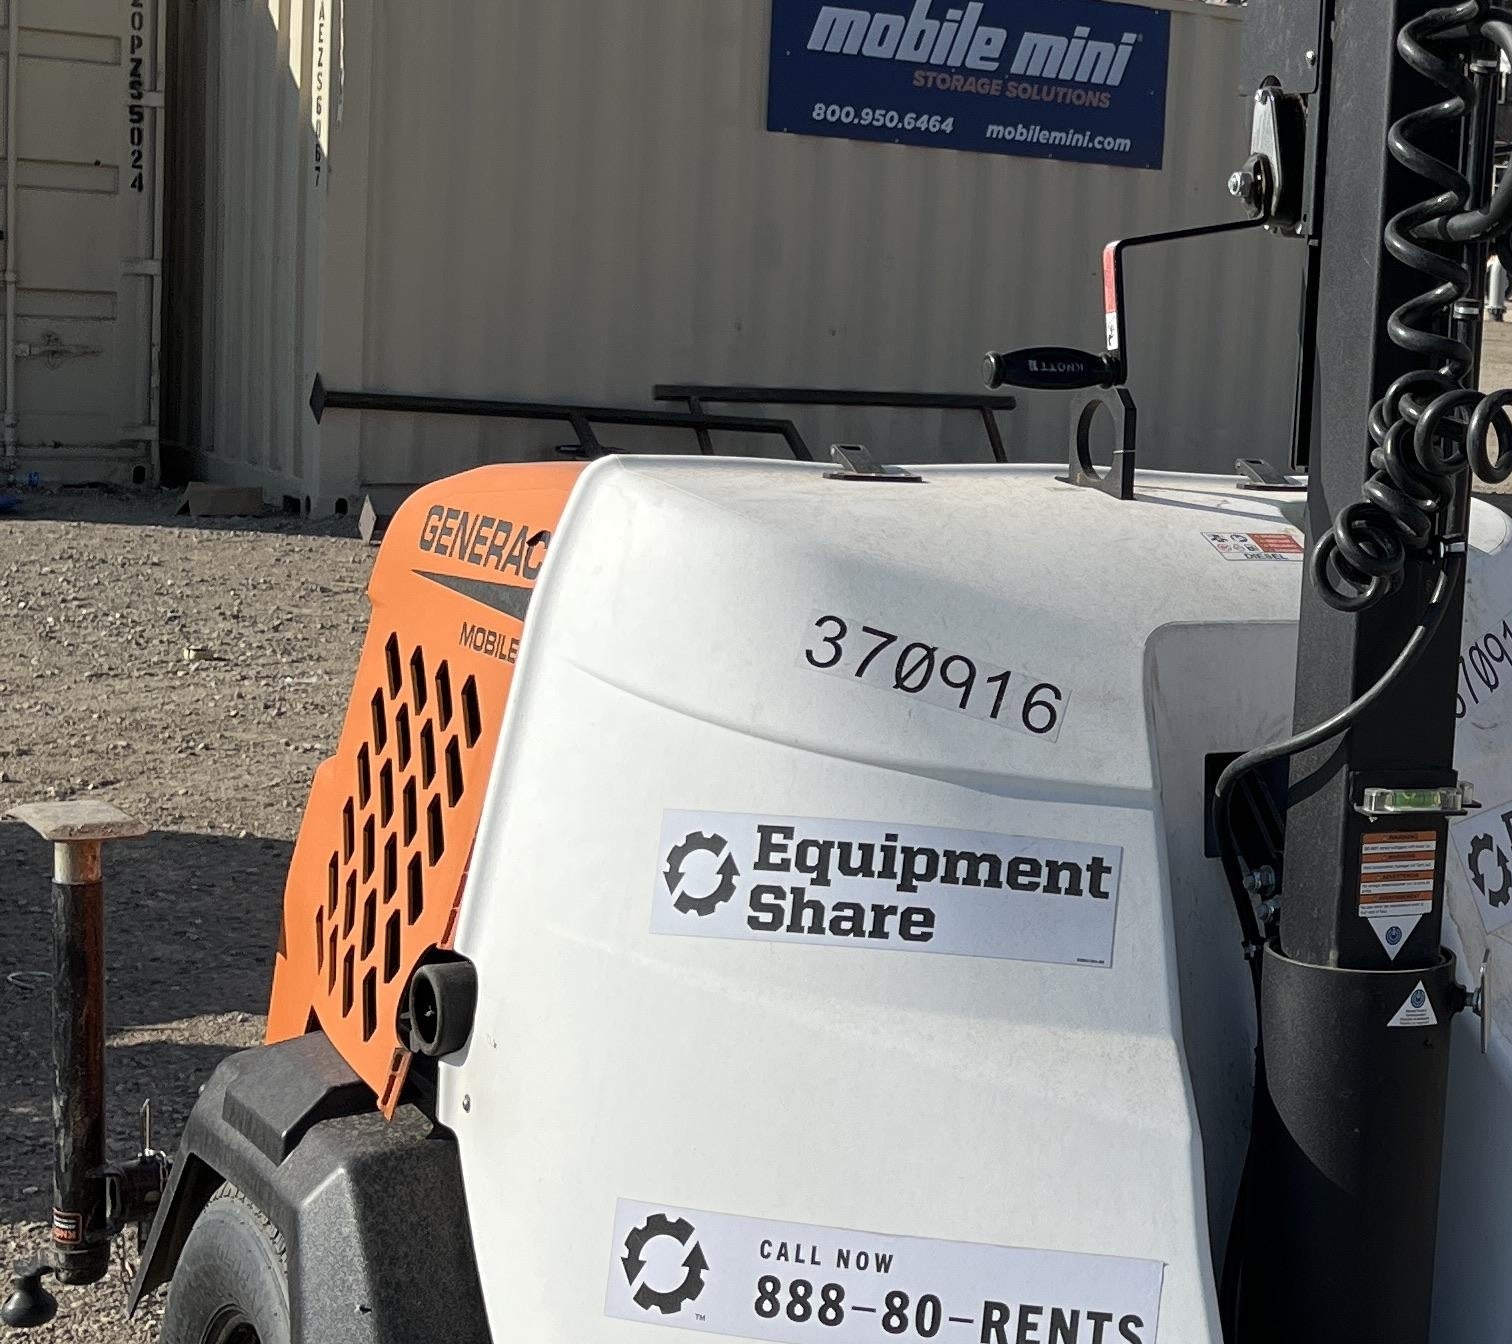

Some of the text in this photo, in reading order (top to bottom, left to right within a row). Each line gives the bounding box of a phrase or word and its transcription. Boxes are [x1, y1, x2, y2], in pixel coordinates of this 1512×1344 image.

[1009, 25, 1139, 86] mini
[913, 69, 1111, 110] STORAGE SOLUTIONS
[812, 102, 1132, 153] 800.950.6464 mobilemini.com
[418, 504, 556, 581] GENERAC
[459, 621, 521, 664] MOBILE
[805, 615, 1063, 734] 370916
[752, 824, 1113, 901] Equipment
[747, 884, 937, 944] Share
[759, 1239, 895, 1275] CALL NOW
